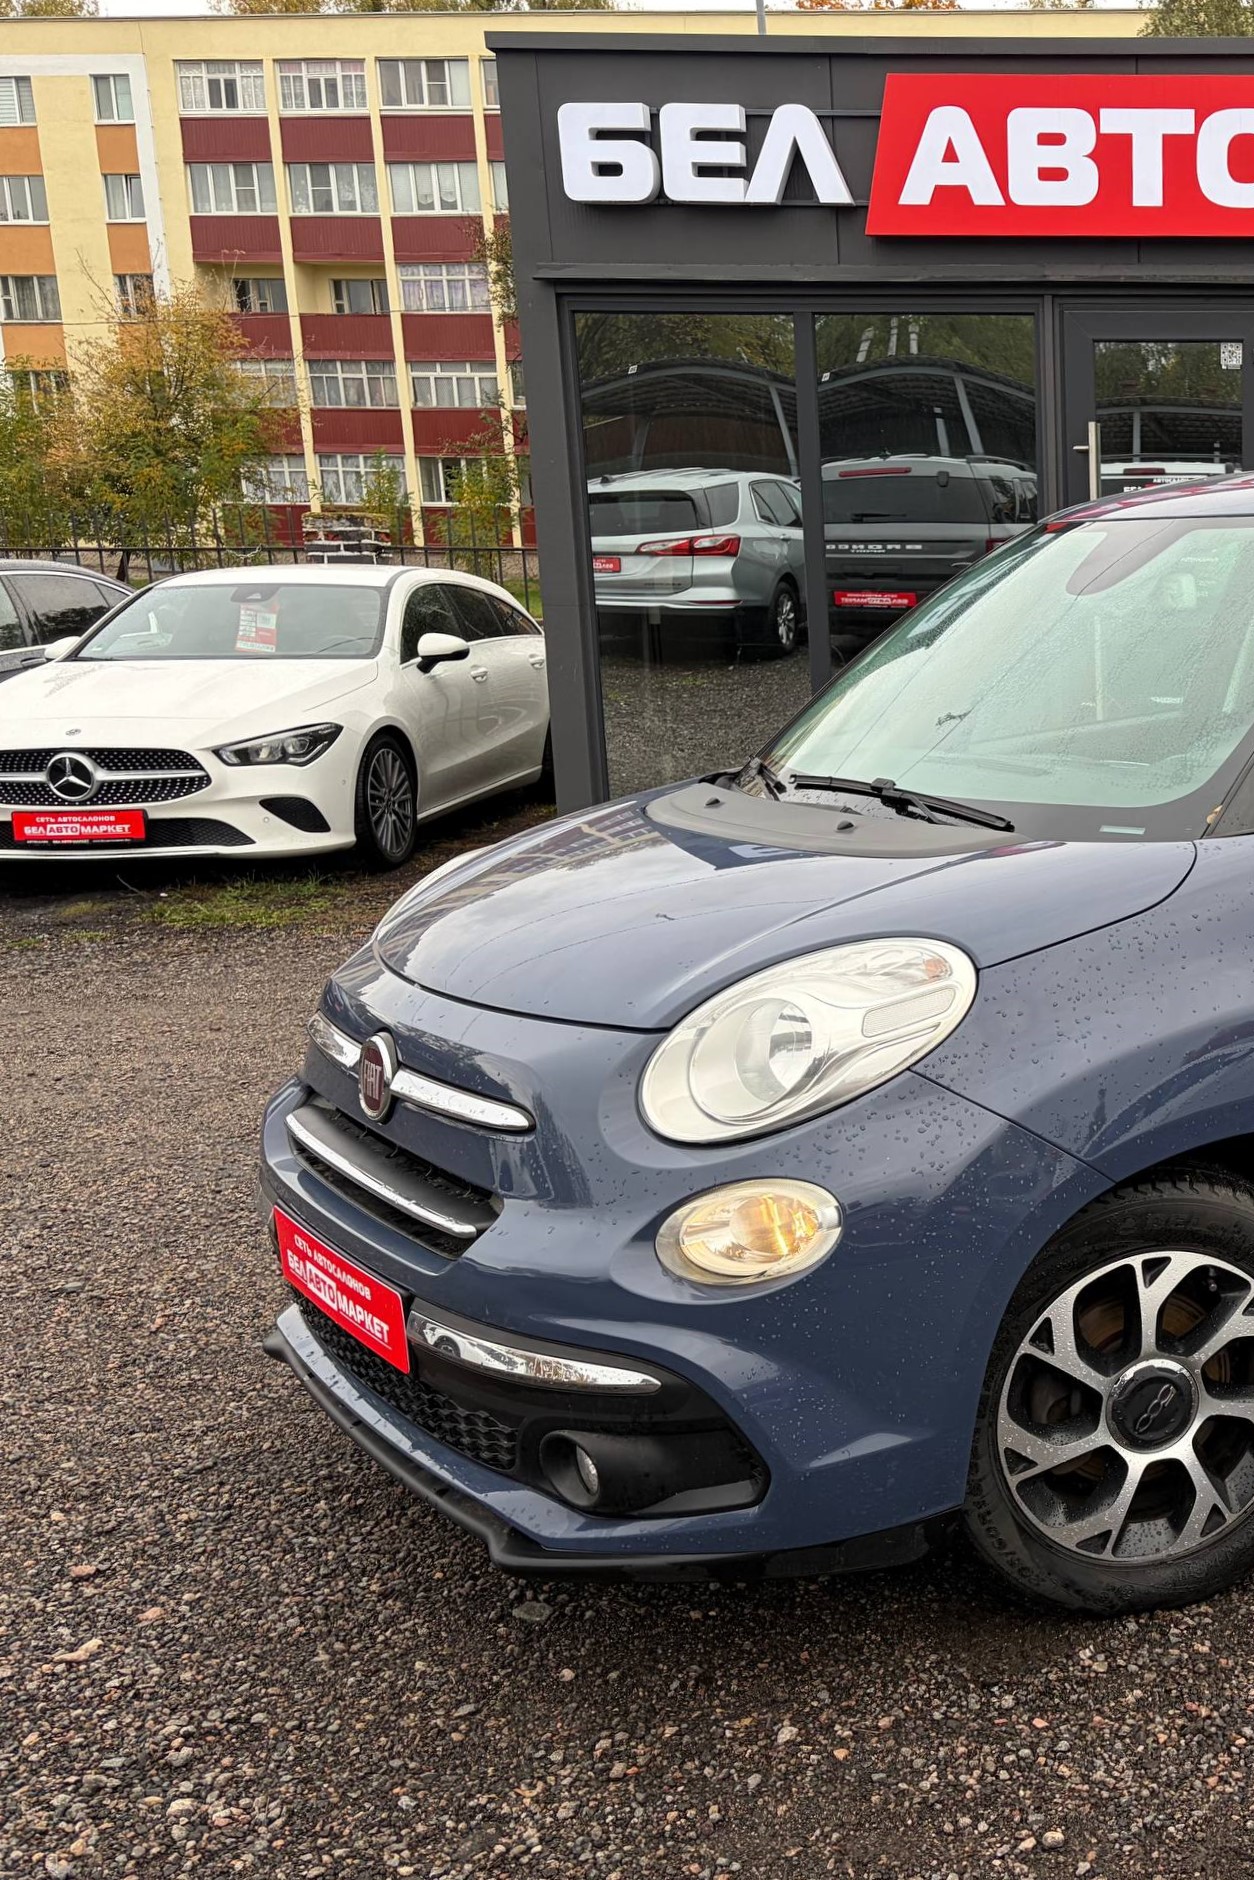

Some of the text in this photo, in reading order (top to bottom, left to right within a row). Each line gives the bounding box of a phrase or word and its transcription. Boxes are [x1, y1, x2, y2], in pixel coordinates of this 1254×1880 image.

[557, 102, 855, 206] БЕЛ
[363, 1059, 382, 1100] FIAT
[294, 1234, 371, 1301] СЕТЬ АВТОСАЛОНОВ
